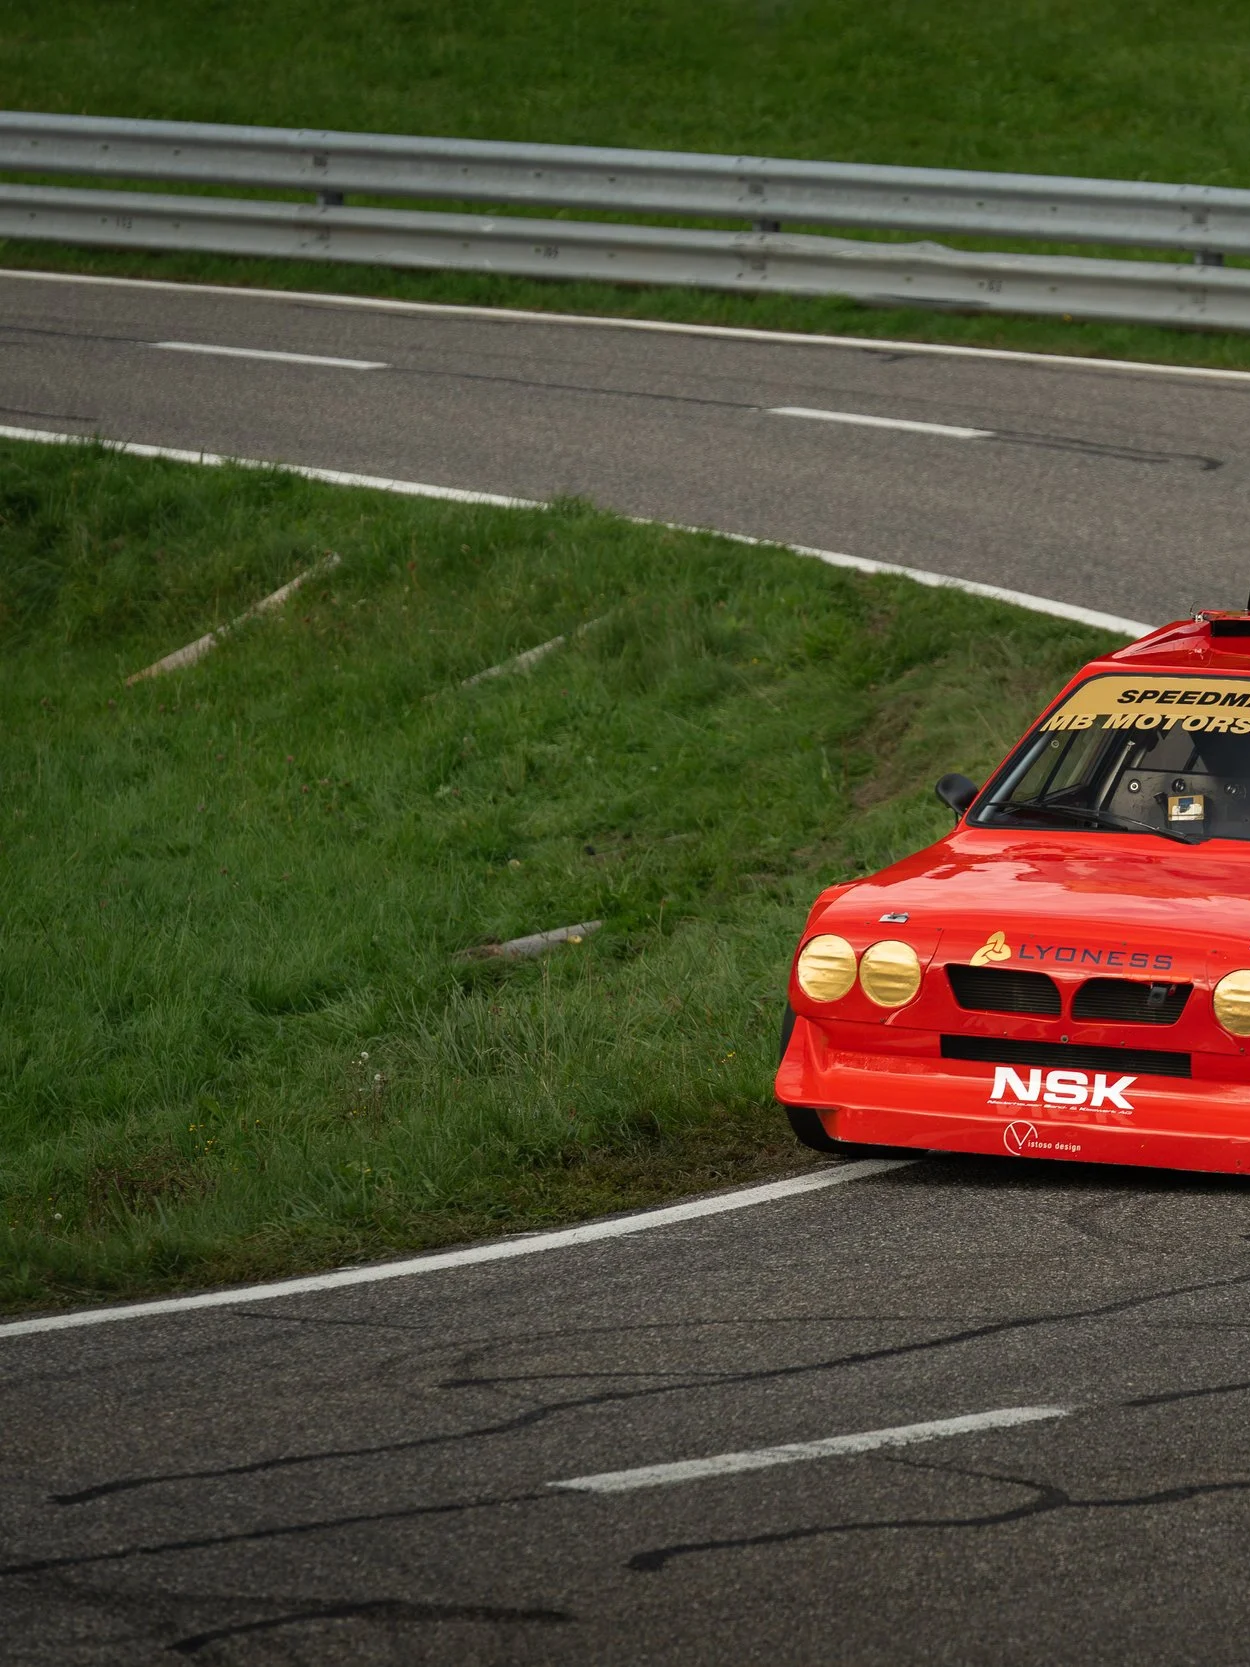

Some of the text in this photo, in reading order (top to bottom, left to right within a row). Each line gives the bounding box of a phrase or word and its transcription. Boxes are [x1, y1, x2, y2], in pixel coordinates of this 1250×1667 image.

[1039, 713, 1097, 732] MB
[1018, 943, 1173, 970] LYONESS
[990, 1066, 1139, 1110] NSK
[1055, 1142, 1081, 1153] design
